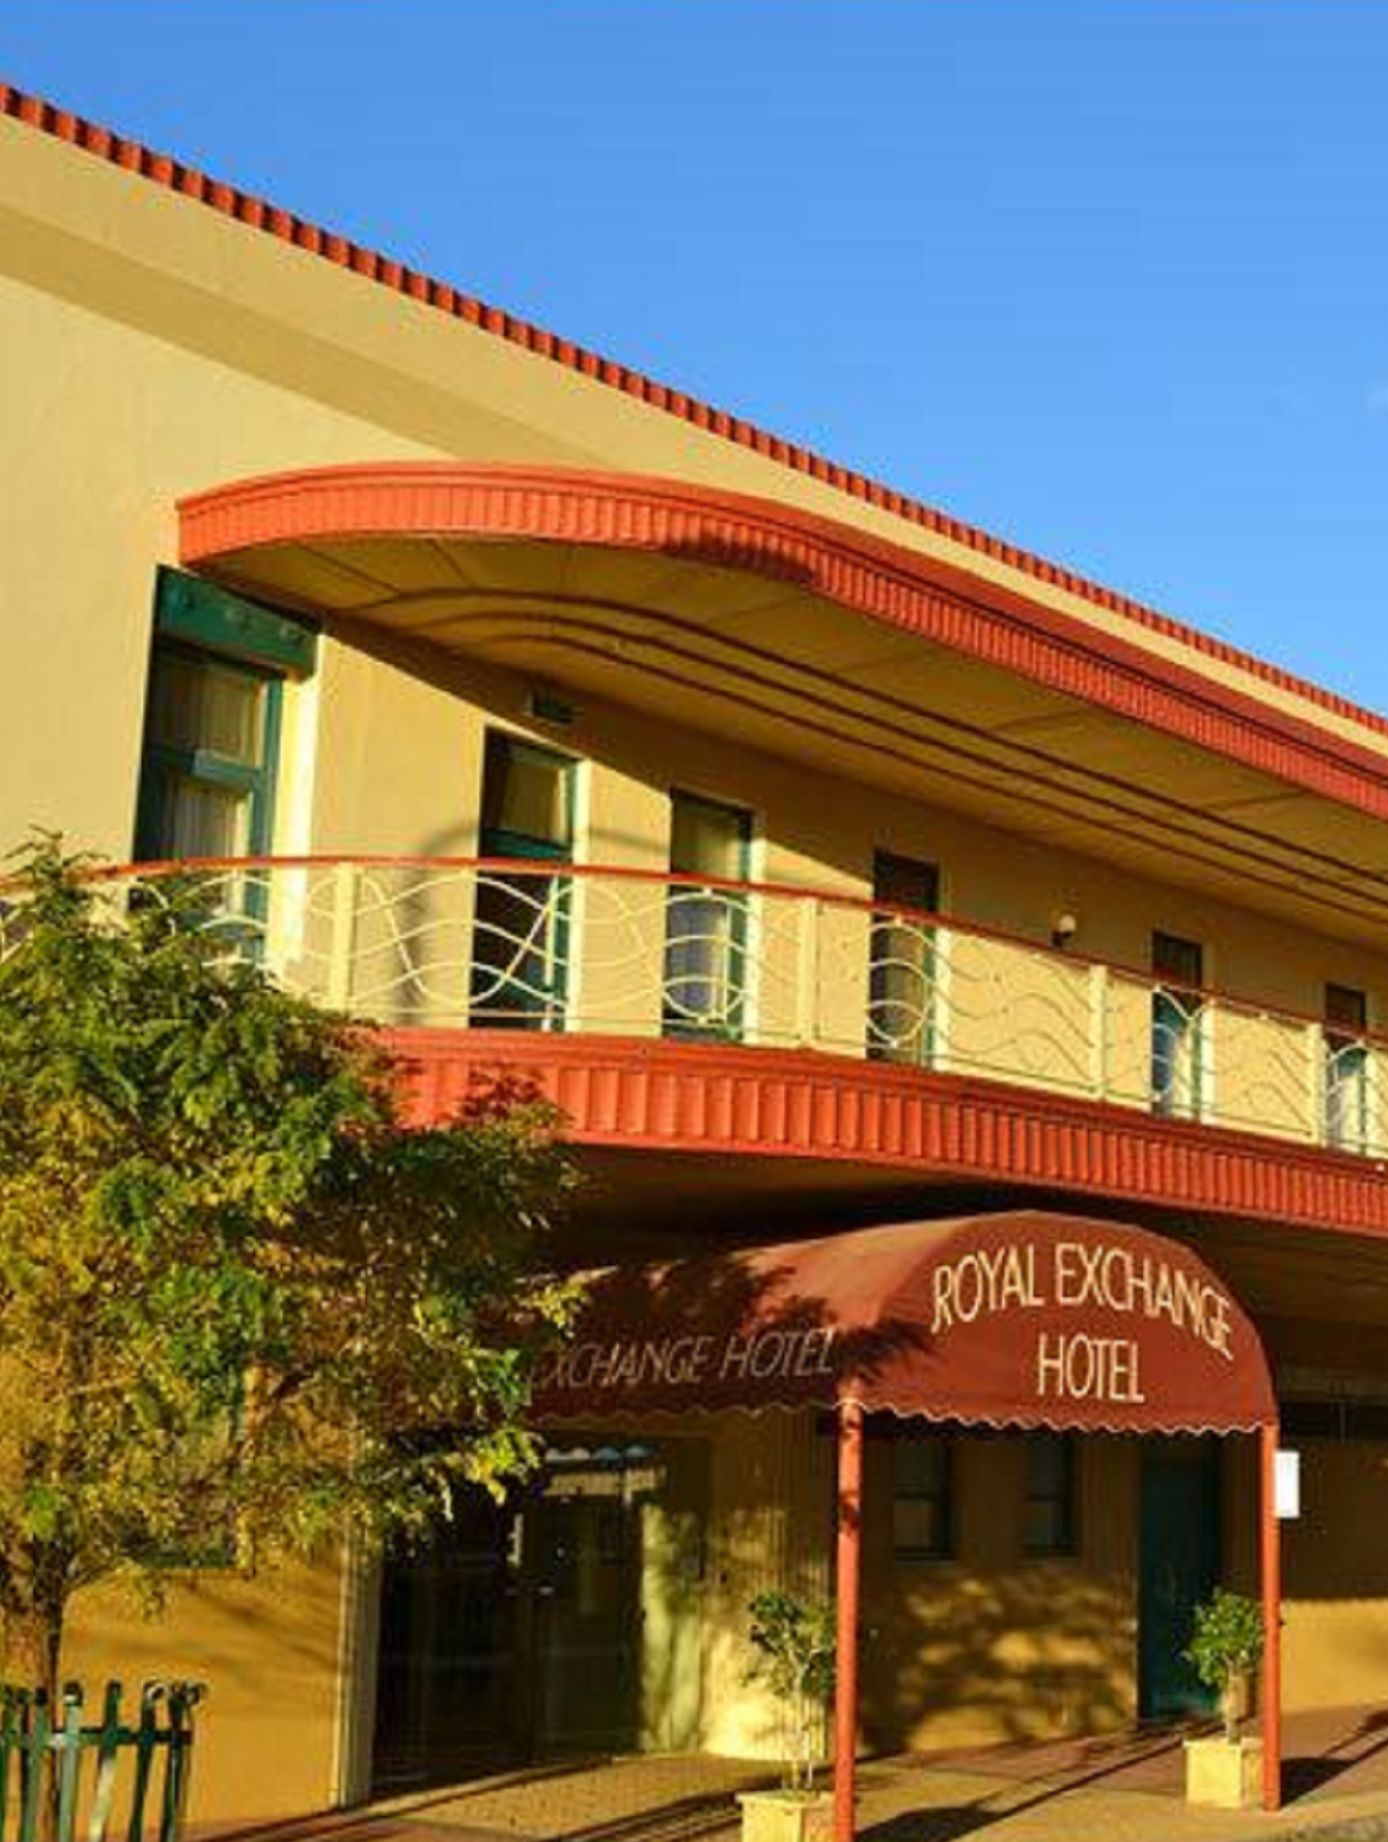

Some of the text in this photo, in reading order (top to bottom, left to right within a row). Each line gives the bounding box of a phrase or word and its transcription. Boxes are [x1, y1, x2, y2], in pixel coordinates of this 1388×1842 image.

[931, 1243, 1233, 1360] ROYAL EXCHANGE
[719, 1327, 835, 1378] HOTEL
[1037, 1333, 1145, 1404] HOTEL
